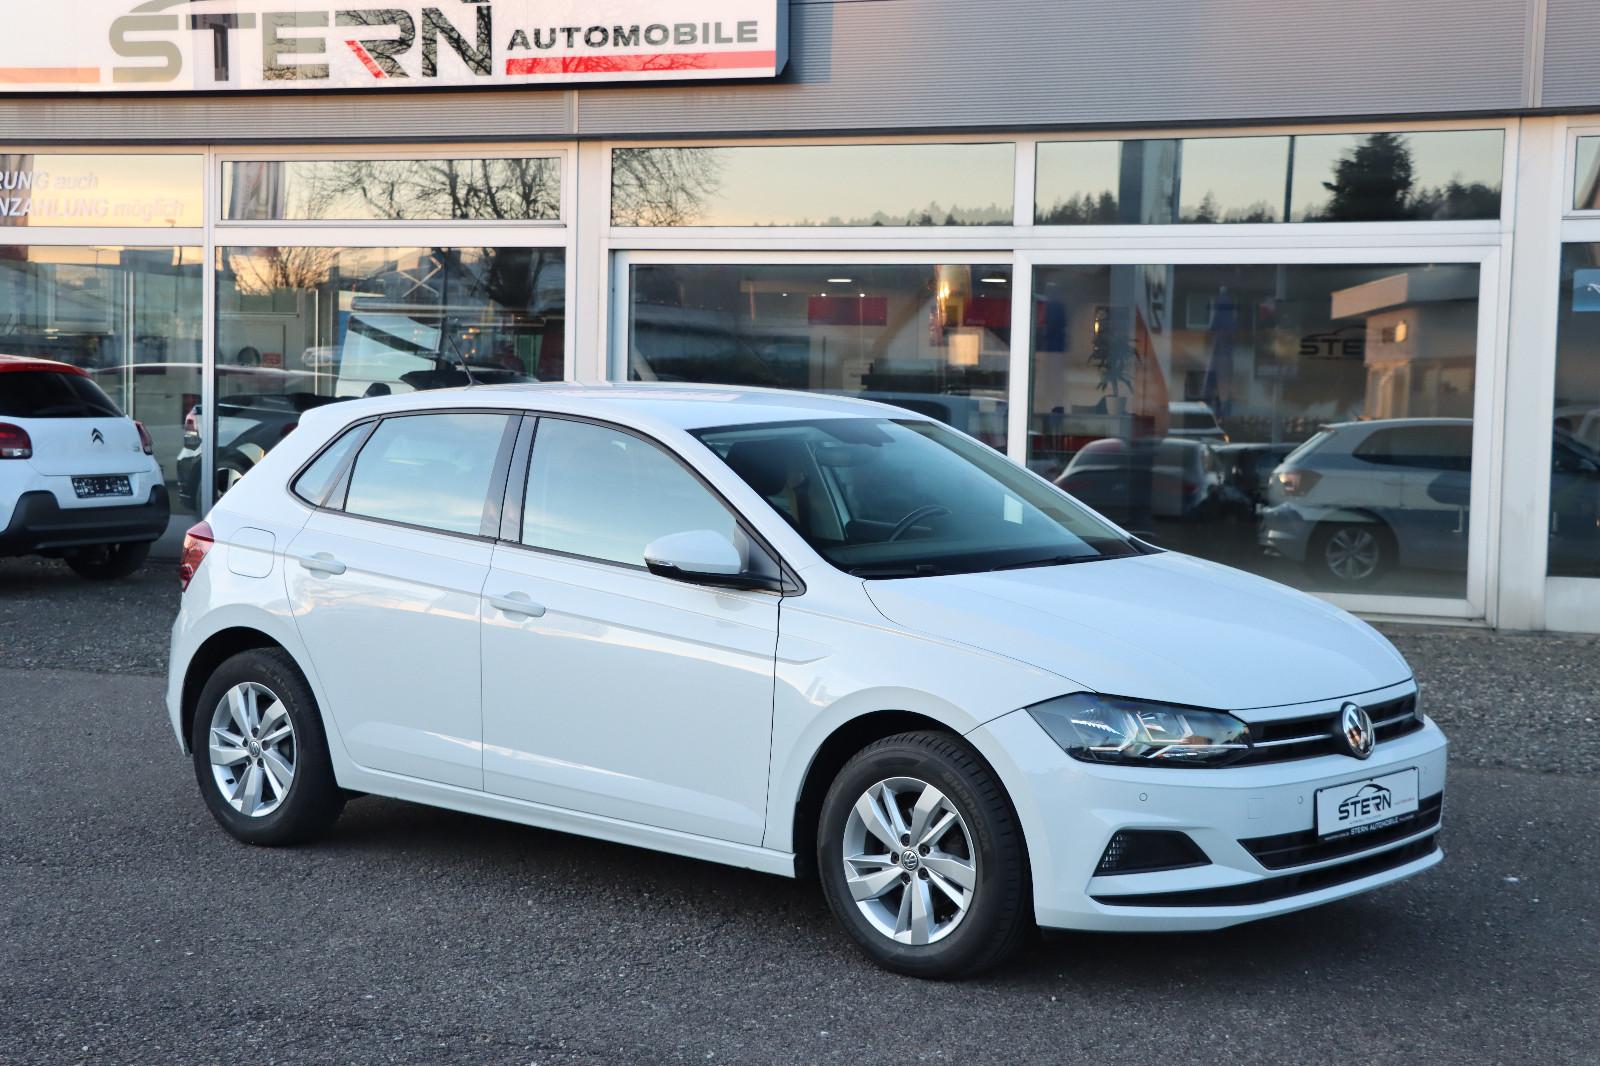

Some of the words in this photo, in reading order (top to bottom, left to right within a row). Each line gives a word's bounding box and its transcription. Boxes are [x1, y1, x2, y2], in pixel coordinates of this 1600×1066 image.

[109, 5, 492, 83] STERN
[507, 20, 758, 50] AUTOMOBILE
[54, 172, 99, 189] auch
[1338, 793, 1391, 821] STERN
